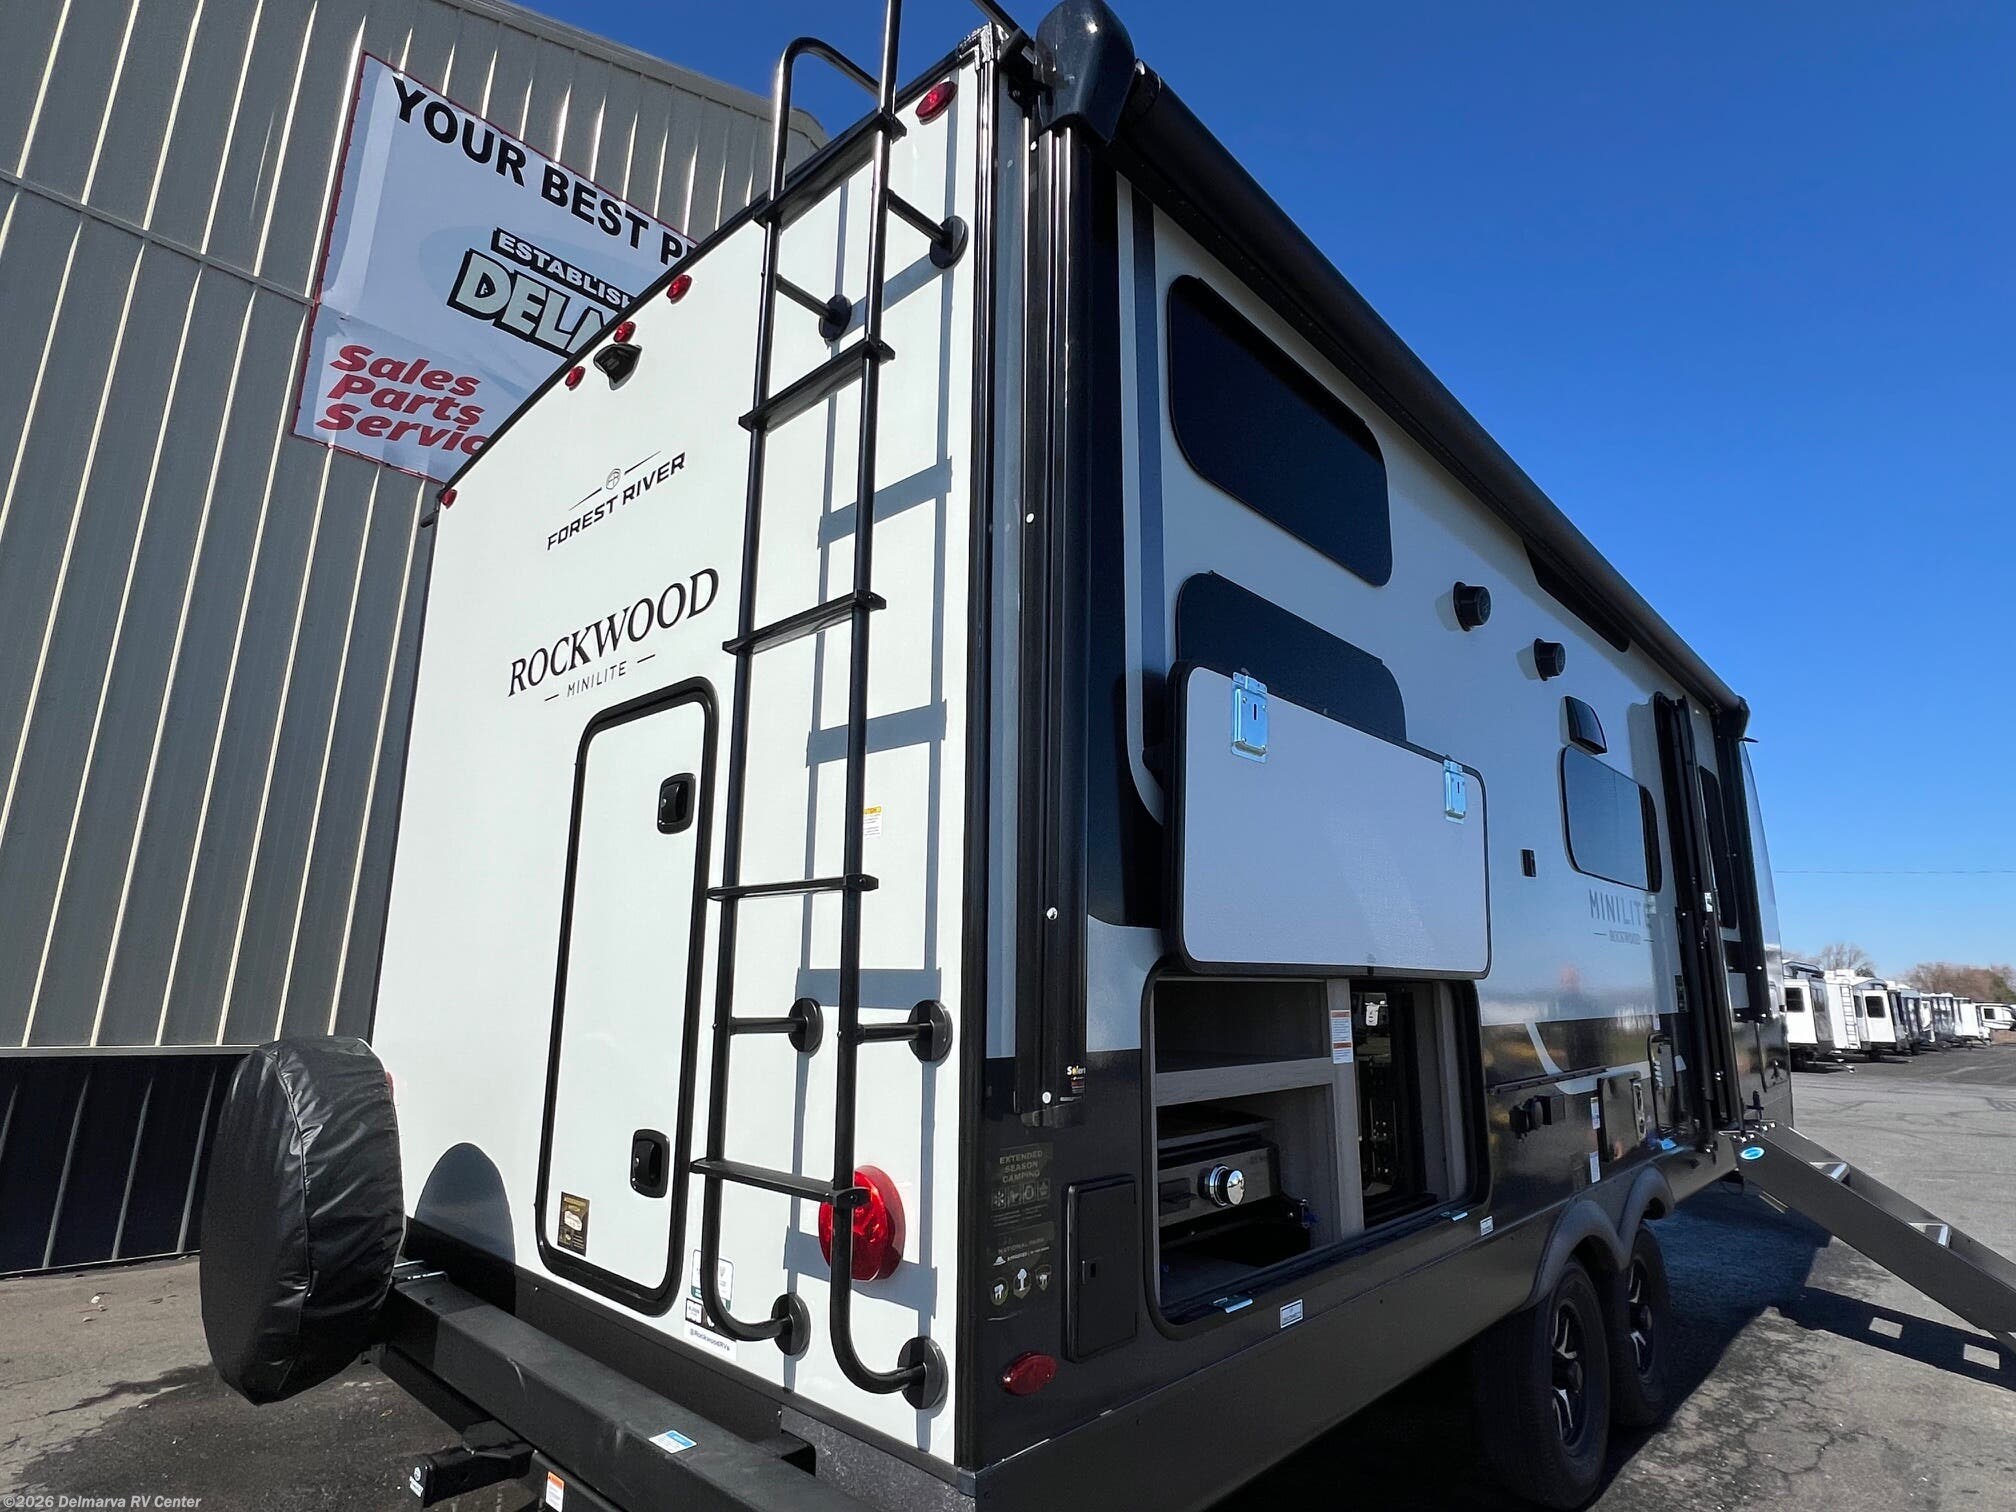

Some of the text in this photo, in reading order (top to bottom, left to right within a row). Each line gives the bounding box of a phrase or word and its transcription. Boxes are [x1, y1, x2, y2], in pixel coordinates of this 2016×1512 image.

[392, 75, 698, 267] YOUR BEST P
[329, 344, 481, 397] Sales
[327, 373, 485, 426] Parts
[547, 451, 686, 551] FOREST RIVER
[508, 567, 720, 698] ROCKWOOD
[566, 660, 628, 698] MINILITE
[999, 1150, 1043, 1165] EXTENDED
[1002, 1170, 1041, 1184] CAMPING
[1004, 1160, 1039, 1174] SEASON
